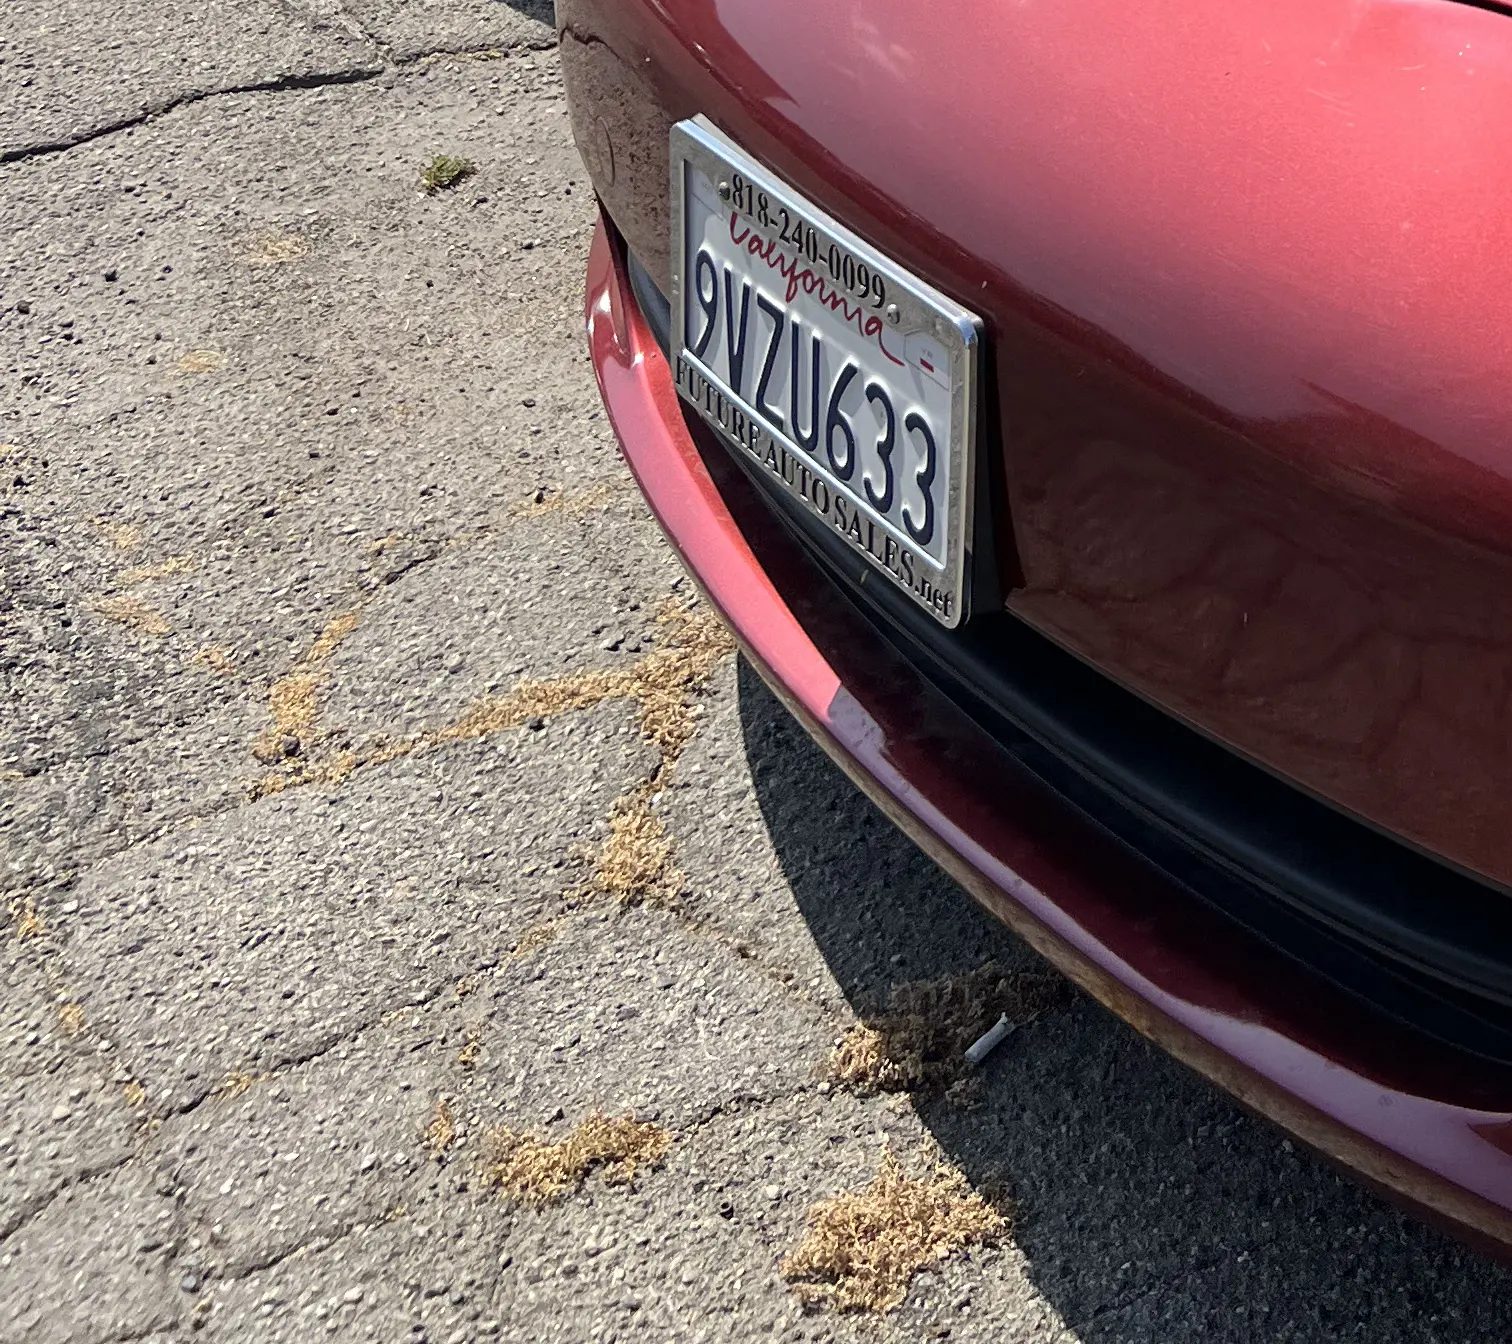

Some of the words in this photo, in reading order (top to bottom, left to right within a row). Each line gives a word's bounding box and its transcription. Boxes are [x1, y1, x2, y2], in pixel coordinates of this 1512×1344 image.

[732, 173, 886, 310] 818-240-0099
[676, 355, 761, 454] FUTURE
[764, 439, 830, 516] AUTO
[691, 248, 937, 546] 9VZU633
